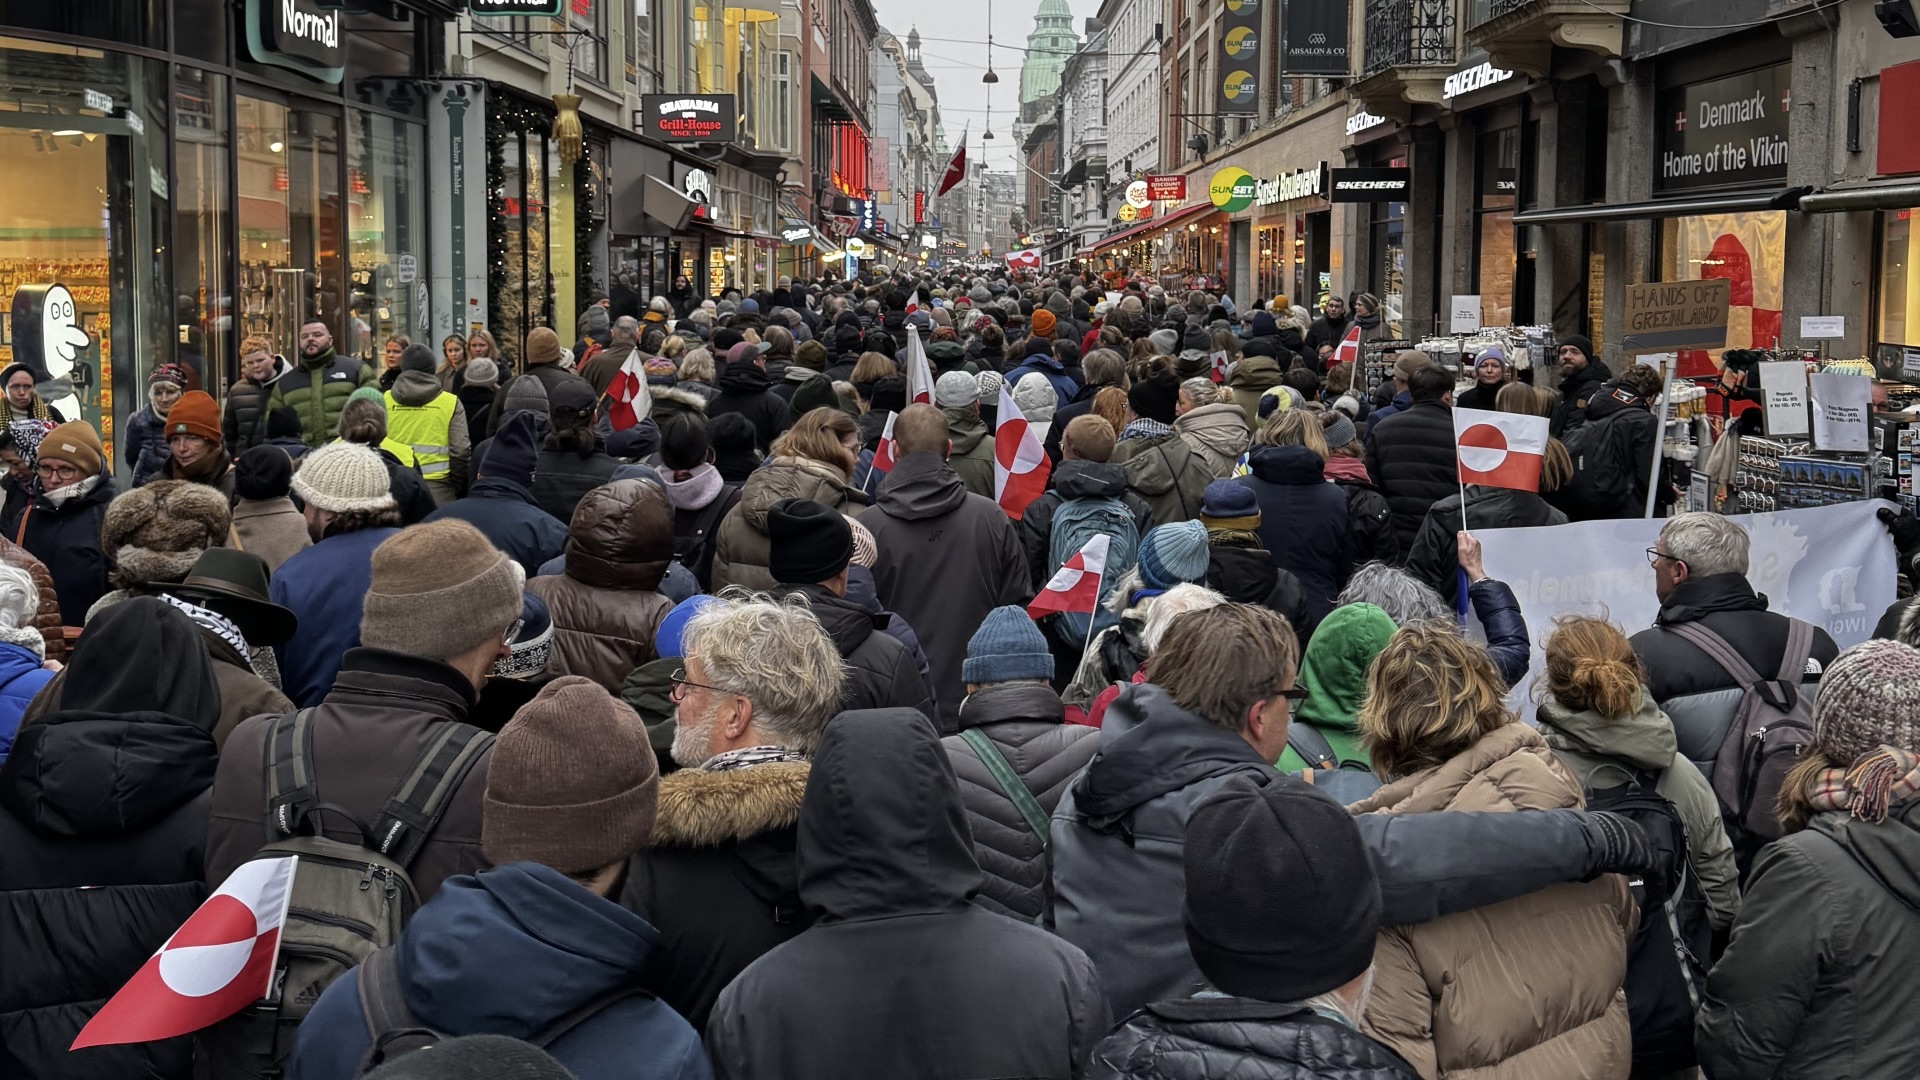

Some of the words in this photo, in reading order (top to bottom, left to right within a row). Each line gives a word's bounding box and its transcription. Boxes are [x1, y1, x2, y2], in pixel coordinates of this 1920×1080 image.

[282, 0, 338, 49] Normal
[1699, 89, 1766, 129] Denmark
[659, 119, 721, 130] Grill-House
[1663, 151, 1702, 178] Home
[1704, 143, 1720, 174] of
[1722, 142, 1747, 171] the
[1750, 134, 1789, 168] Vikin
[1211, 185, 1254, 195] SUNSET
[1255, 174, 1280, 207] Sunset
[1279, 160, 1322, 203] Boulevard
[1335, 180, 1406, 190] SKECHERS
[1632, 285, 1687, 309] HANDS
[1693, 283, 1725, 304] OFF
[1631, 306, 1720, 331] GREENLAND
